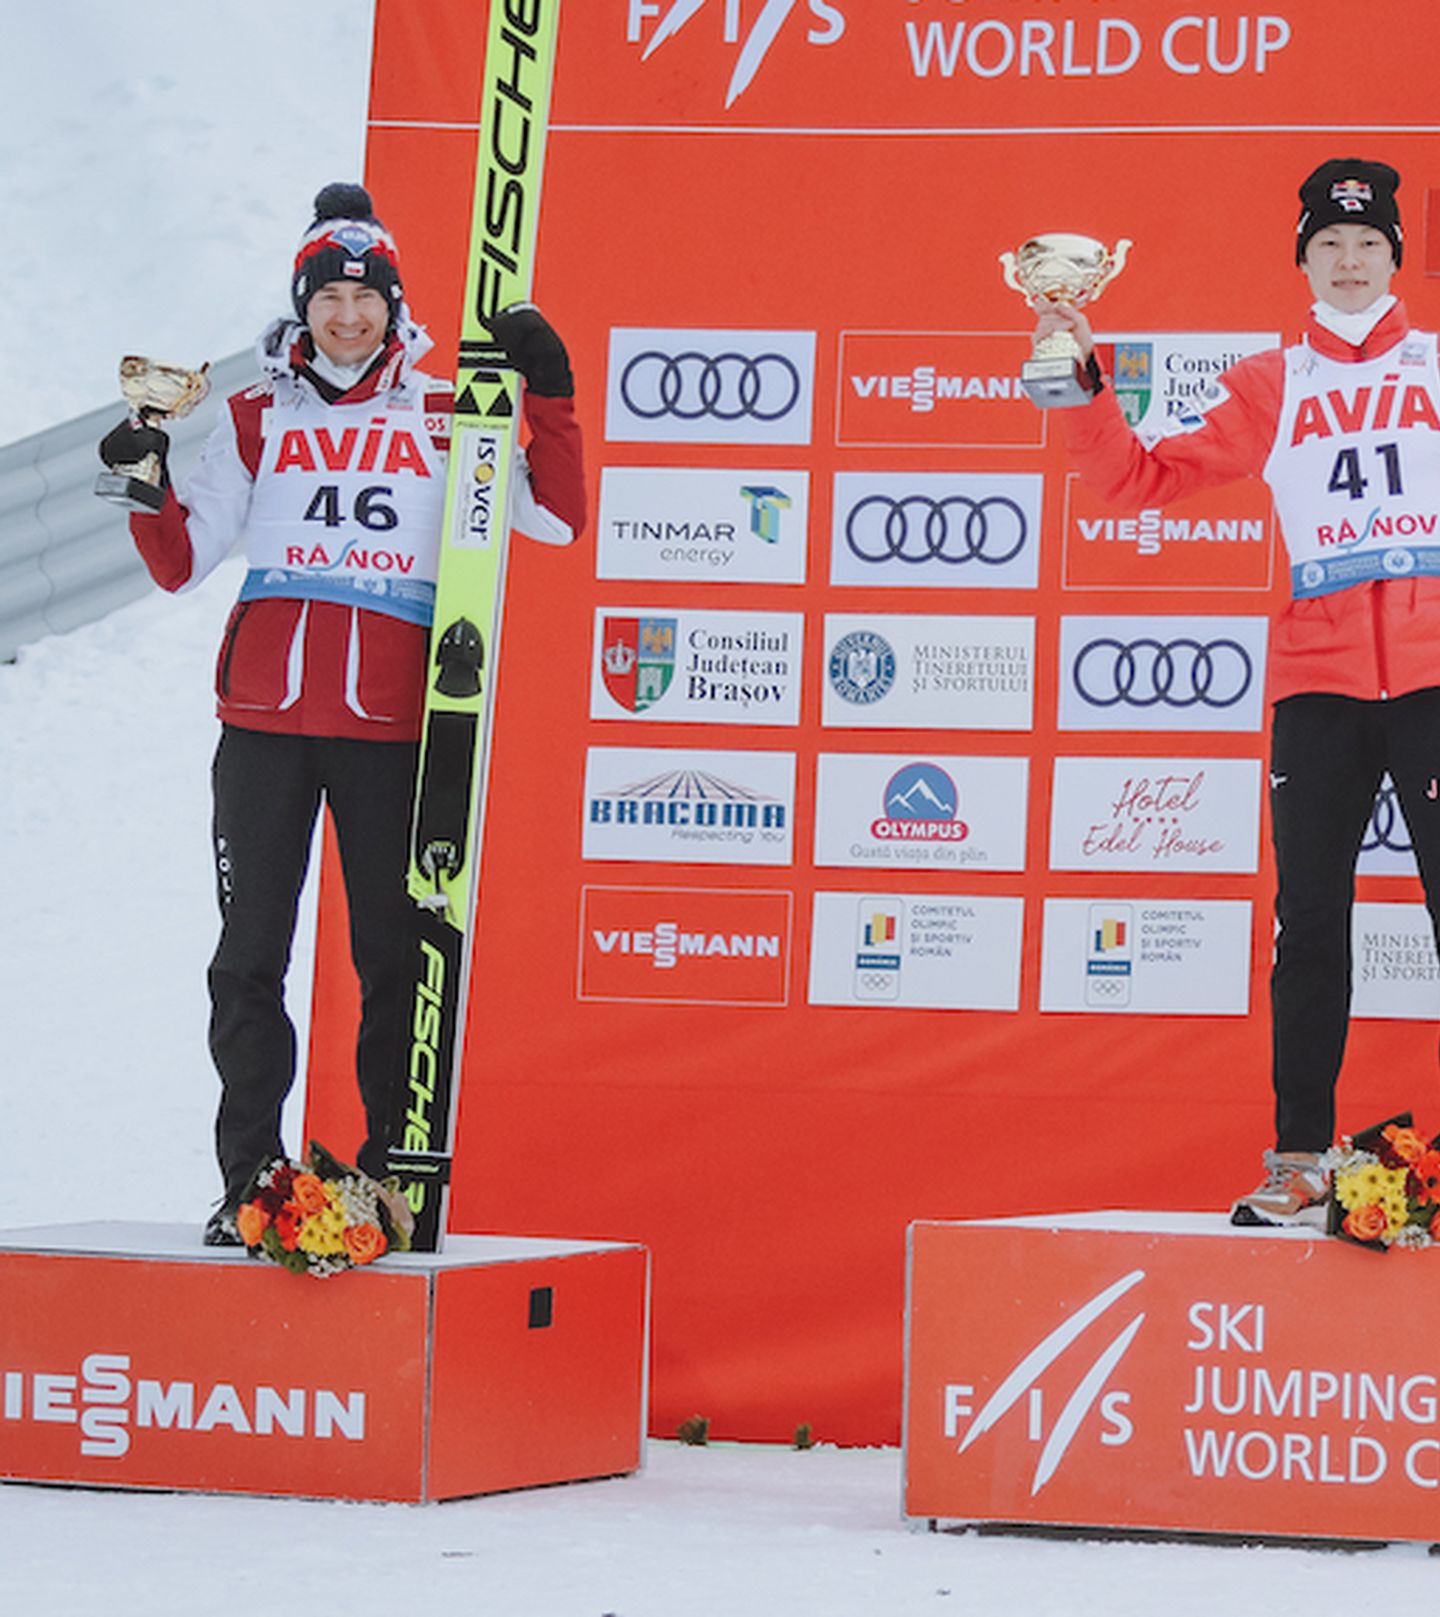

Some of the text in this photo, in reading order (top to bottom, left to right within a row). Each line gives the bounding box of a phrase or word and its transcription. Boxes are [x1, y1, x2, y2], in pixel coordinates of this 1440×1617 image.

[905, 15, 1292, 78] WORLD CUP
[1327, 442, 1404, 501] 41
[303, 484, 399, 532] 46
[612, 520, 735, 542] TINMAR
[1077, 509, 1264, 556] VIESSMANN
[659, 547, 735, 567] energy
[687, 629, 788, 653] Consiliul
[913, 645, 1028, 661] MINISTERUL
[914, 661, 1028, 677] TINERETULUI
[933, 677, 1028, 693] SPORTULUI
[1112, 771, 1205, 818] Hotel
[590, 799, 786, 829] BRACOMA
[671, 828, 756, 844] Respecting
[875, 820, 964, 840] OLYMPUS
[1082, 823, 1226, 859] Edel House
[933, 846, 957, 860] din
[959, 847, 988, 863] plin
[910, 904, 976, 917] COMITETUL
[1141, 909, 1204, 921] COMITETUL
[910, 918, 958, 931] OLIMPIC
[1140, 924, 1187, 935] OLIMPIC
[593, 922, 780, 969] VIESSMANN
[924, 932, 974, 944] SPORTIV
[1153, 937, 1202, 949] SPORTIV
[1362, 932, 1431, 949] MINIST
[1363, 949, 1435, 965] TINERET
[1187, 1302, 1266, 1352] SKI
[1184, 1365, 1438, 1424] JUMPING
[4, 1353, 366, 1458] IESSMANN
[1184, 1428, 1389, 1484] WORLD
